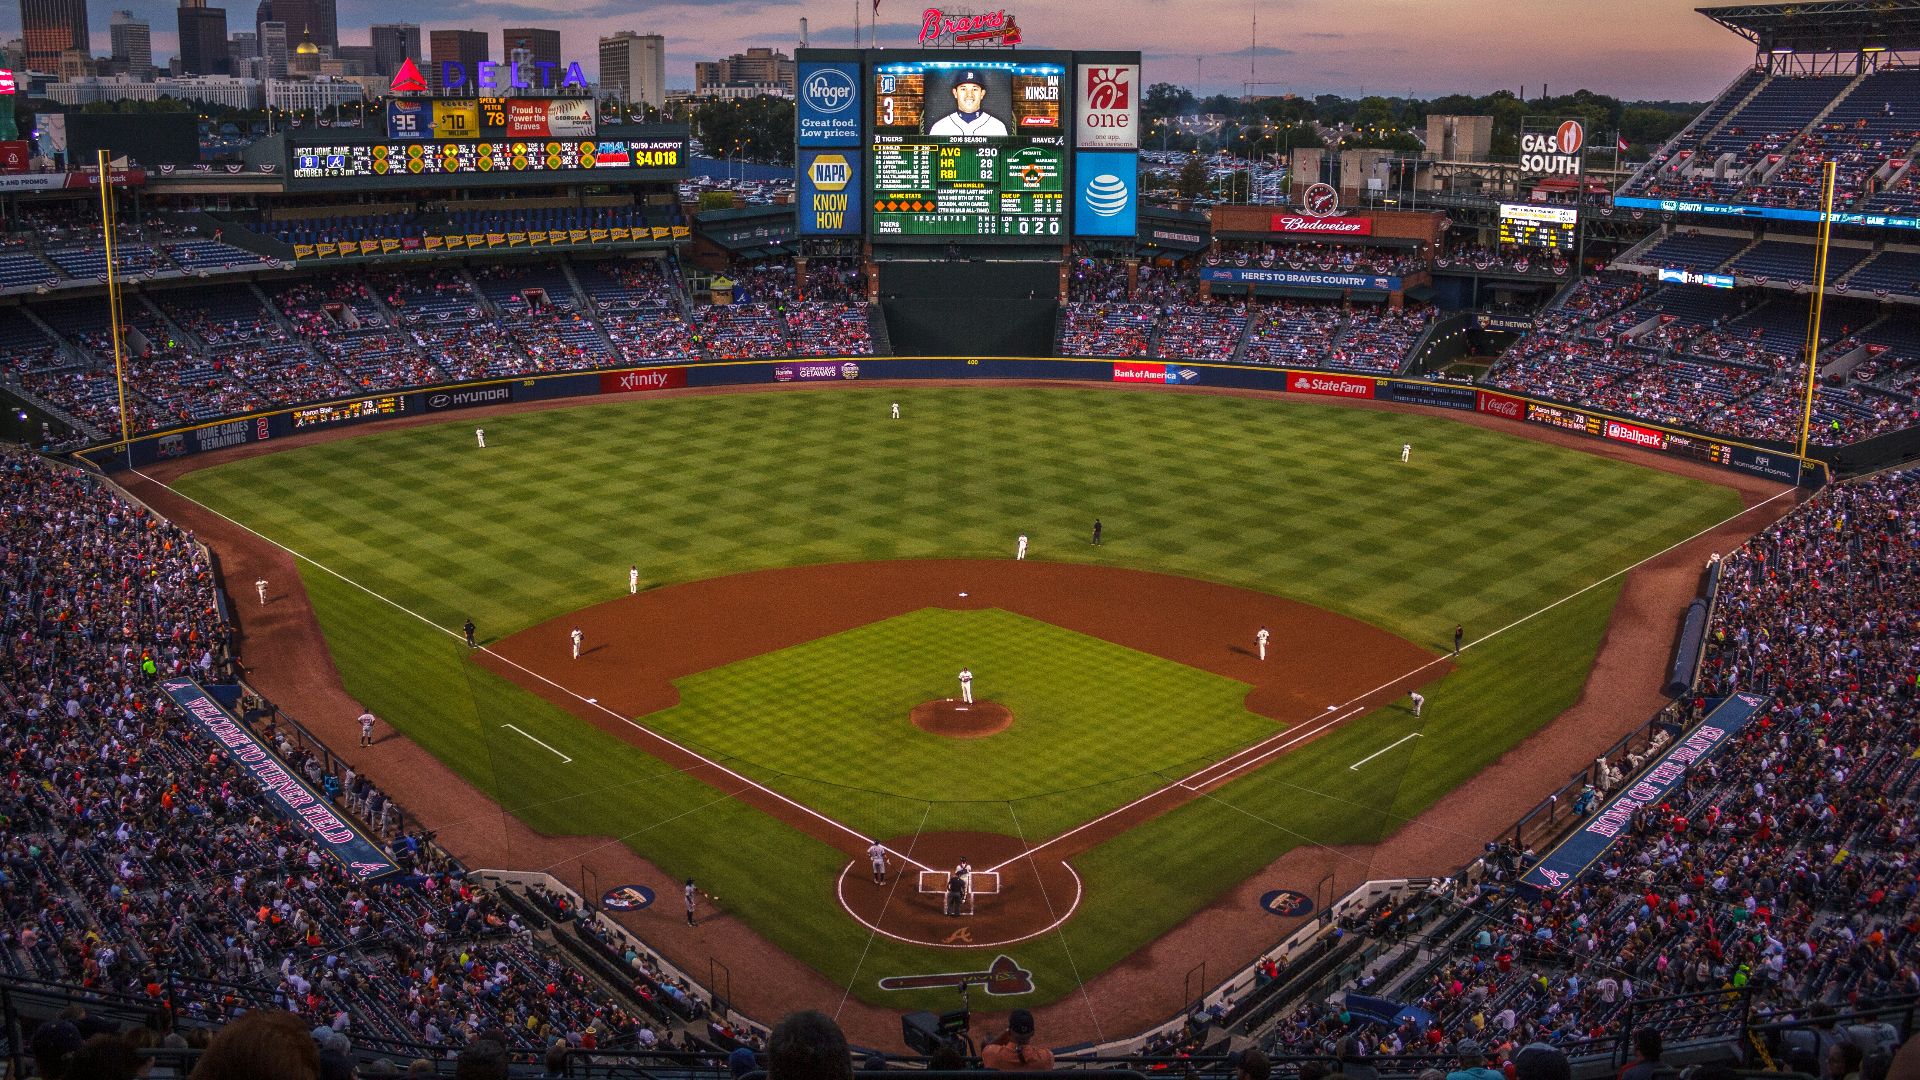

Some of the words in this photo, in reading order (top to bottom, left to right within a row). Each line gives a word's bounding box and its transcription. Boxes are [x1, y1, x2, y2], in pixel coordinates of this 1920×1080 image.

[919, 8, 1005, 43] Braves
[442, 61, 587, 88] DELTA
[1048, 76, 1058, 86] IAN
[810, 77, 850, 106] Kroger
[1026, 87, 1058, 100] KINSLER
[511, 106, 533, 114] Proud
[884, 97, 894, 125] 3
[486, 112, 505, 126] 78
[509, 114, 532, 123] Power
[533, 114, 546, 122] the
[802, 119, 831, 127] Great
[832, 119, 857, 127] food.
[1087, 114, 1129, 128] one
[515, 123, 540, 131] Braves
[801, 129, 822, 137] Low
[824, 129, 858, 138] prices.
[297, 148, 313, 156] NEXT
[314, 147, 332, 155] HOME
[333, 147, 350, 155] GAME
[1522, 135, 1557, 153] GAS
[636, 151, 677, 167] $4,018
[941, 148, 961, 157] AVG
[976, 148, 998, 157] .290
[941, 159, 954, 168] HR
[981, 159, 993, 168] 28
[1521, 155, 1580, 175] SOUTH
[294, 169, 323, 177] OCTOBER
[325, 169, 329, 177] 2
[816, 164, 846, 182] NAPA
[941, 170, 957, 178] RBI
[981, 170, 993, 179] 82
[813, 194, 848, 211] KNOW
[1679, 203, 1701, 212] SOUTH
[816, 212, 844, 229] HOW
[1020, 222, 1029, 234] 0
[1035, 222, 1044, 234] 2
[1050, 222, 1059, 234] 0
[1281, 218, 1360, 231] Budweiser
[1867, 217, 1886, 225] GAME
[1242, 273, 1272, 281] HERE'S
[1287, 275, 1321, 283] BRAVES
[1323, 277, 1366, 286] COUNTRY
[1688, 274, 1704, 284] 7:10
[1505, 320, 1532, 328] NETWOR
[620, 371, 667, 390] xfinity
[1114, 370, 1134, 379] Bank
[1134, 370, 1143, 379] of
[1143, 370, 1177, 380] America
[453, 388, 509, 404] HYUNDAI
[302, 409, 319, 417] Aaron
[363, 401, 373, 409] 78
[363, 408, 378, 416] MPH
[1535, 406, 1550, 414] Aaron
[1550, 409, 1562, 417] Blair
[1575, 415, 1584, 423] 78
[196, 427, 220, 441] HOME
[222, 421, 249, 436] GAMES
[257, 417, 269, 440] 2
[1619, 427, 1661, 446] Ballpark
[201, 433, 246, 451] REMAINING
[1734, 460, 1763, 472] NORTHSIDE
[1765, 468, 1791, 478] HOSPITAL
[184, 696, 252, 748] WELCOME
[233, 744, 267, 763] TO
[249, 758, 315, 809] TURNER
[1586, 798, 1640, 838] HOME
[1627, 780, 1663, 801] OF
[1646, 761, 1687, 786] THE
[1668, 725, 1726, 765] BRAVES
[298, 803, 355, 845] FIELD
